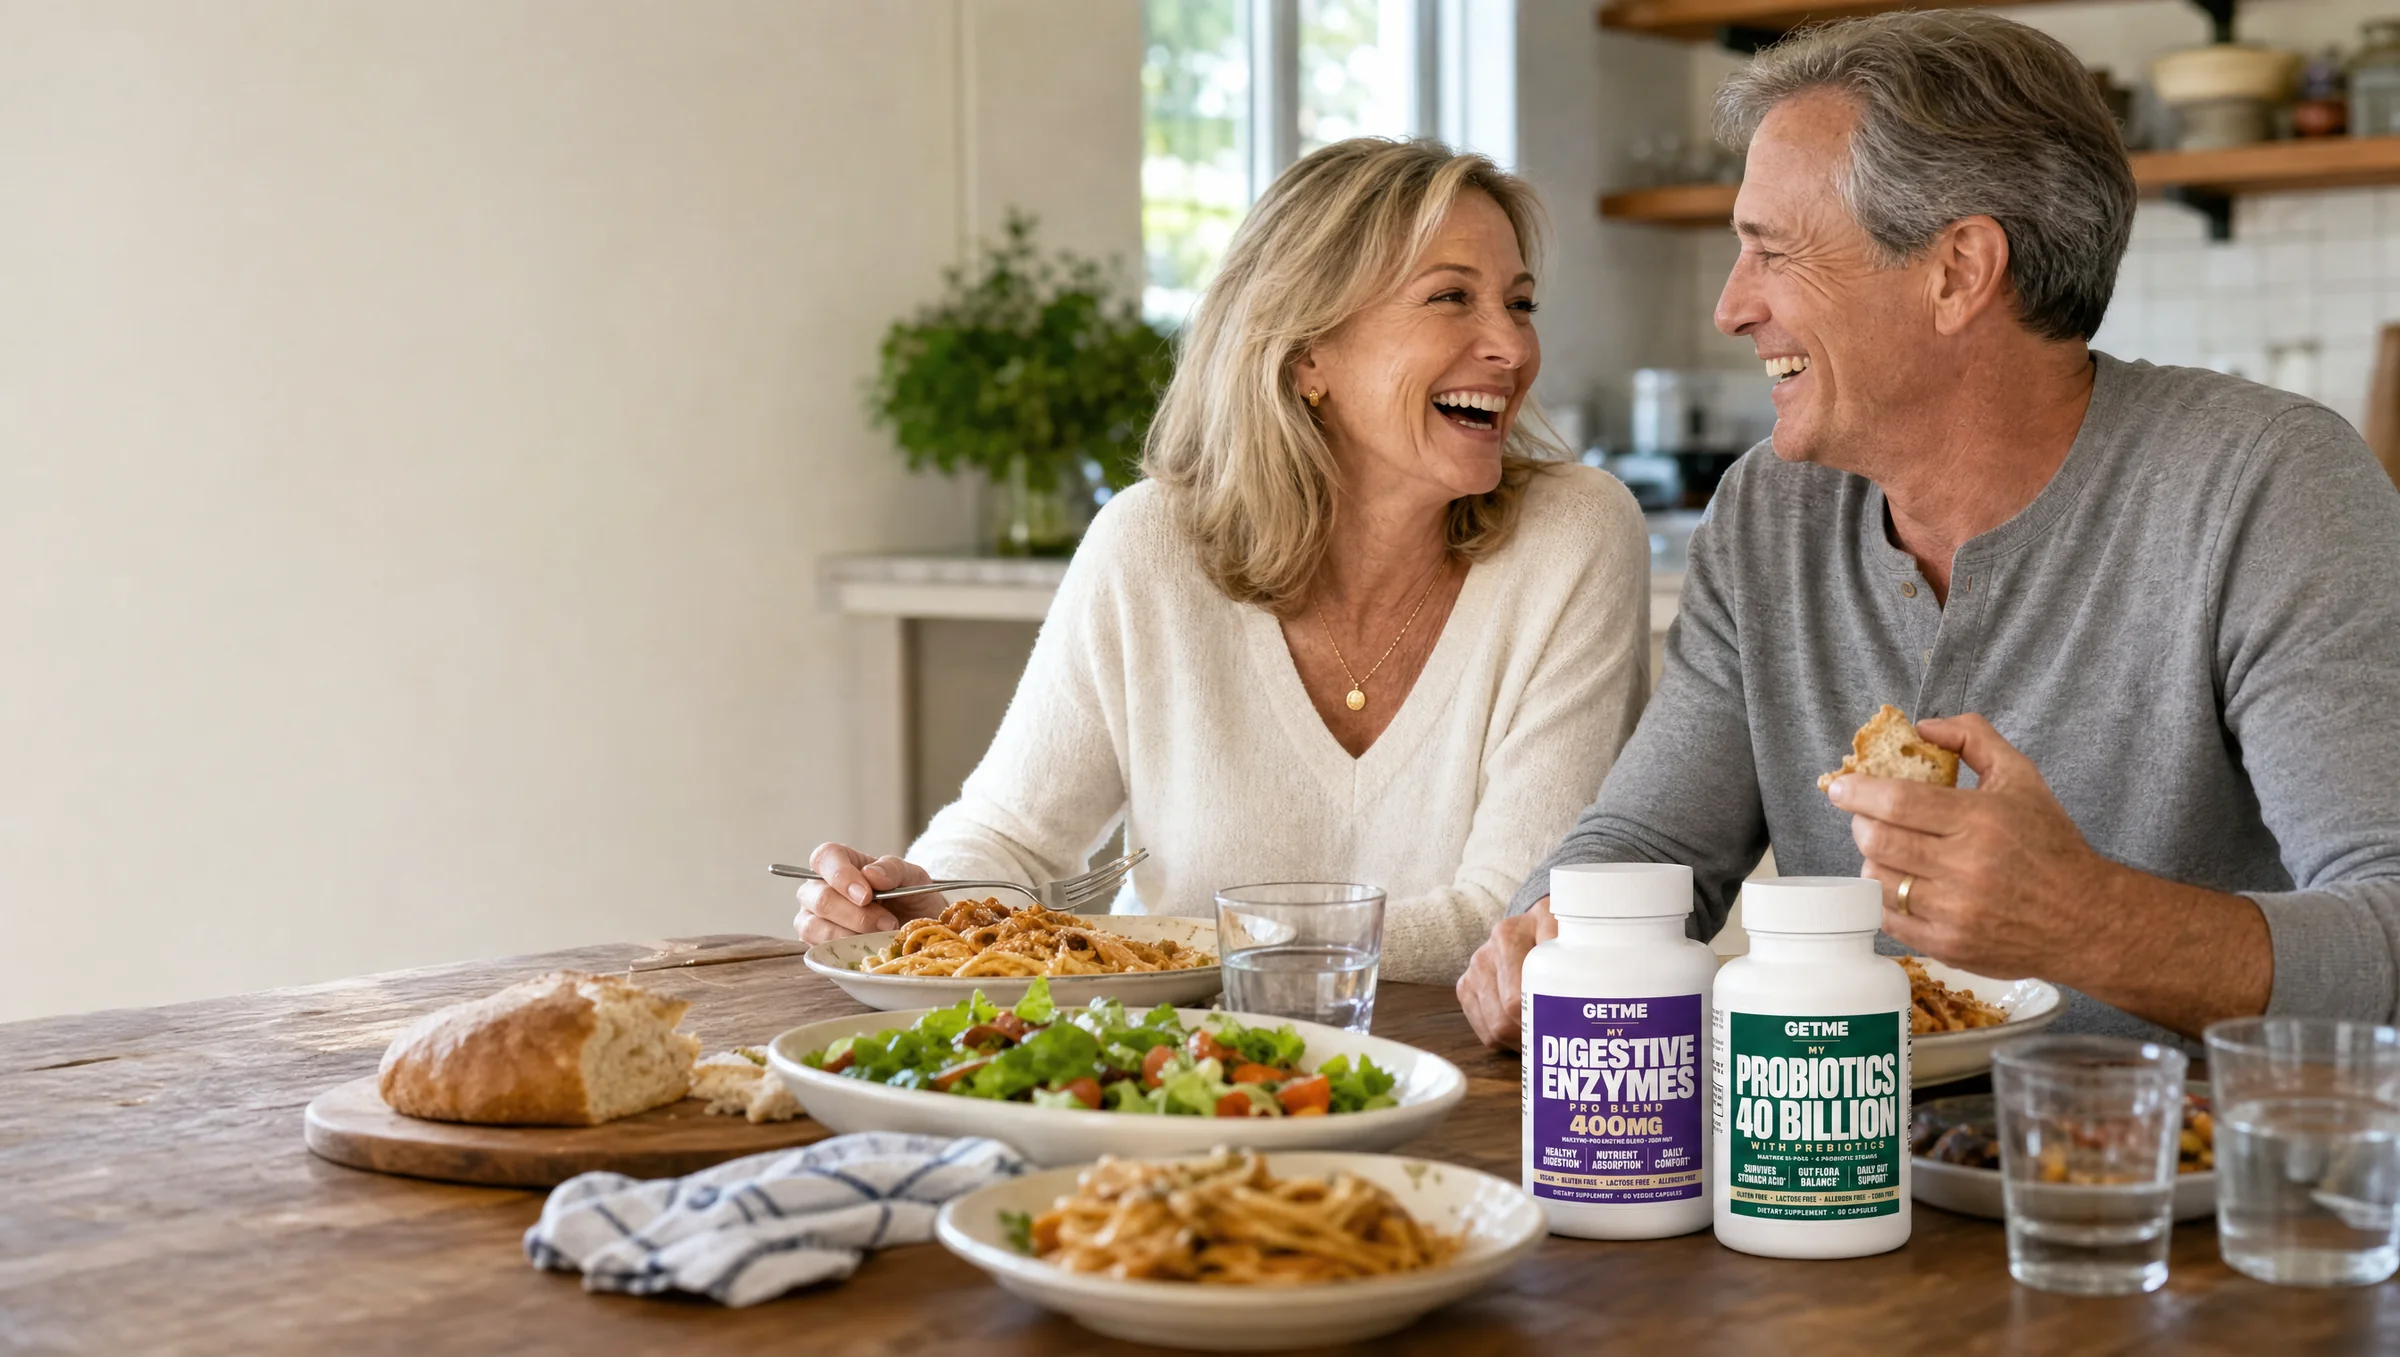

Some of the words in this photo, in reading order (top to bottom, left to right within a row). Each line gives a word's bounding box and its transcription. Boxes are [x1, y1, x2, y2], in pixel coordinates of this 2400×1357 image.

[1583, 1003, 1648, 1019] GETME
[1784, 1021, 1849, 1036] GETME
[1542, 1034, 1695, 1069] DIGESTIVE
[1808, 1046, 1824, 1054] MY
[1736, 1053, 1895, 1099] PROBIOTICS
[1542, 1066, 1695, 1102] ENZYMES
[1570, 1103, 1600, 1112] PRO
[1611, 1103, 1663, 1113] BLEND
[1736, 1097, 1773, 1139] 40
[1780, 1096, 1895, 1141] BILLION
[1570, 1115, 1663, 1136] 400MG
[1751, 1141, 1786, 1152] WITH
[1795, 1140, 1884, 1152] PREBIOTICS
[1545, 1147, 1577, 1159] HEALTHY
[1596, 1150, 1638, 1159] NUTRIENT
[1663, 1147, 1683, 1158] DAILY
[1744, 1164, 1776, 1175] SURVIVES
[1798, 1167, 1814, 1176] GUT
[1815, 1167, 1839, 1176] FLORA
[1857, 1165, 1875, 1175] DAILY
[1876, 1164, 1888, 1172] GUT
[1738, 1175, 1767, 1185] STOMACH
[1776, 1195, 1802, 1203] LACTOSE
[1757, 1206, 1782, 1215] DIETARY
[1784, 1208, 1827, 1216] SUPPLEMENT
[1848, 1206, 1877, 1215] CAPSULES
